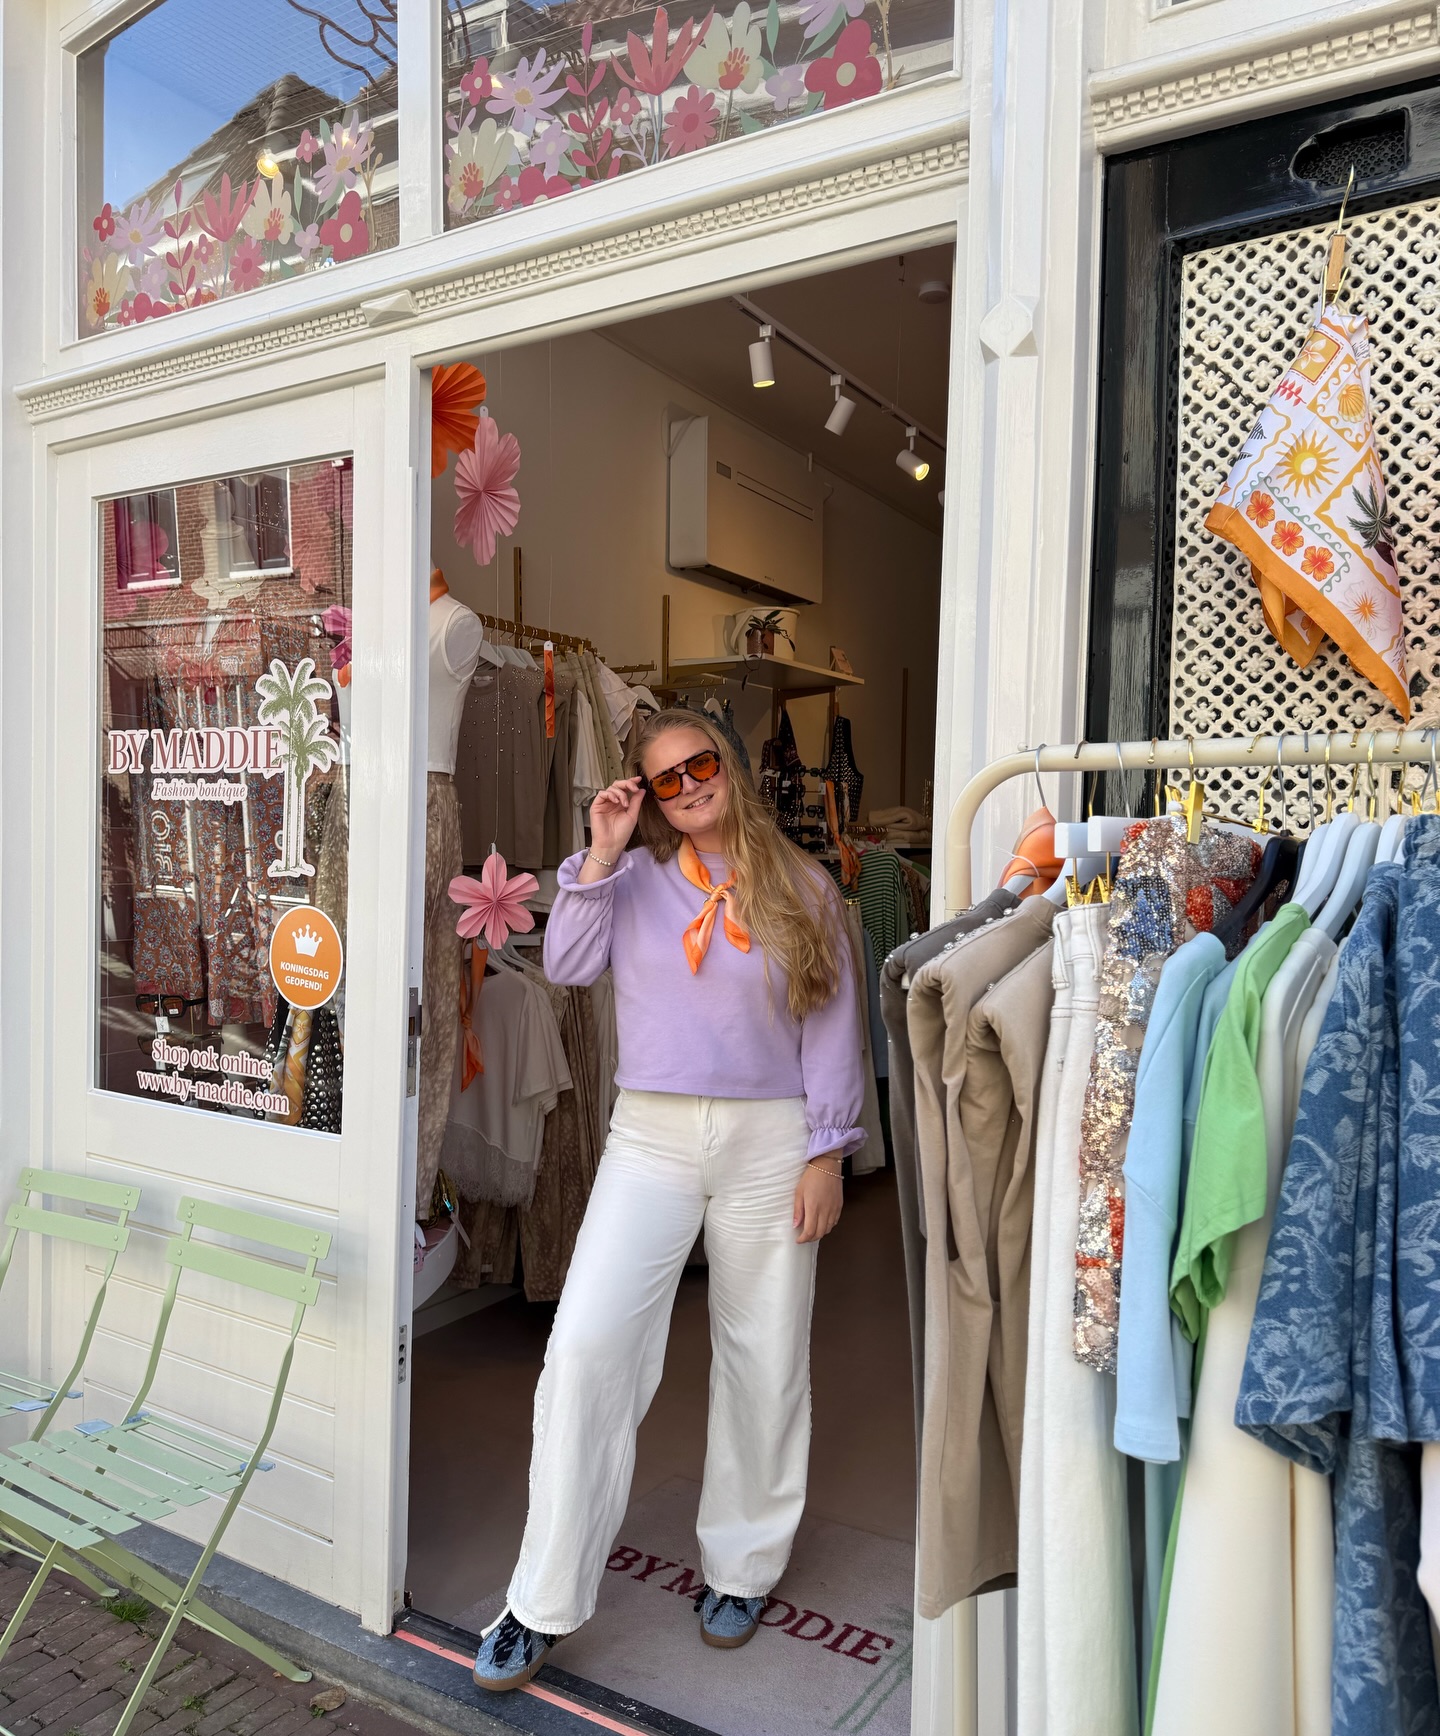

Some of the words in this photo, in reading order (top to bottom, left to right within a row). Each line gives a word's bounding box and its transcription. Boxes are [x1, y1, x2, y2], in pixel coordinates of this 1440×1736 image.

[109, 733, 146, 770] BY
[153, 729, 283, 769] MADDIE
[153, 781, 196, 797] Fashion
[199, 781, 246, 802] boutique
[280, 961, 329, 980] KONINGSDAG
[285, 975, 323, 992] GEOPEND!
[152, 1040, 189, 1070] Shop
[191, 1047, 219, 1069] ook
[220, 1050, 273, 1078] online:
[137, 1071, 290, 1113] www.by-maddie.com
[606, 1546, 688, 1582] BY
[660, 1567, 895, 1665] MDDIE
